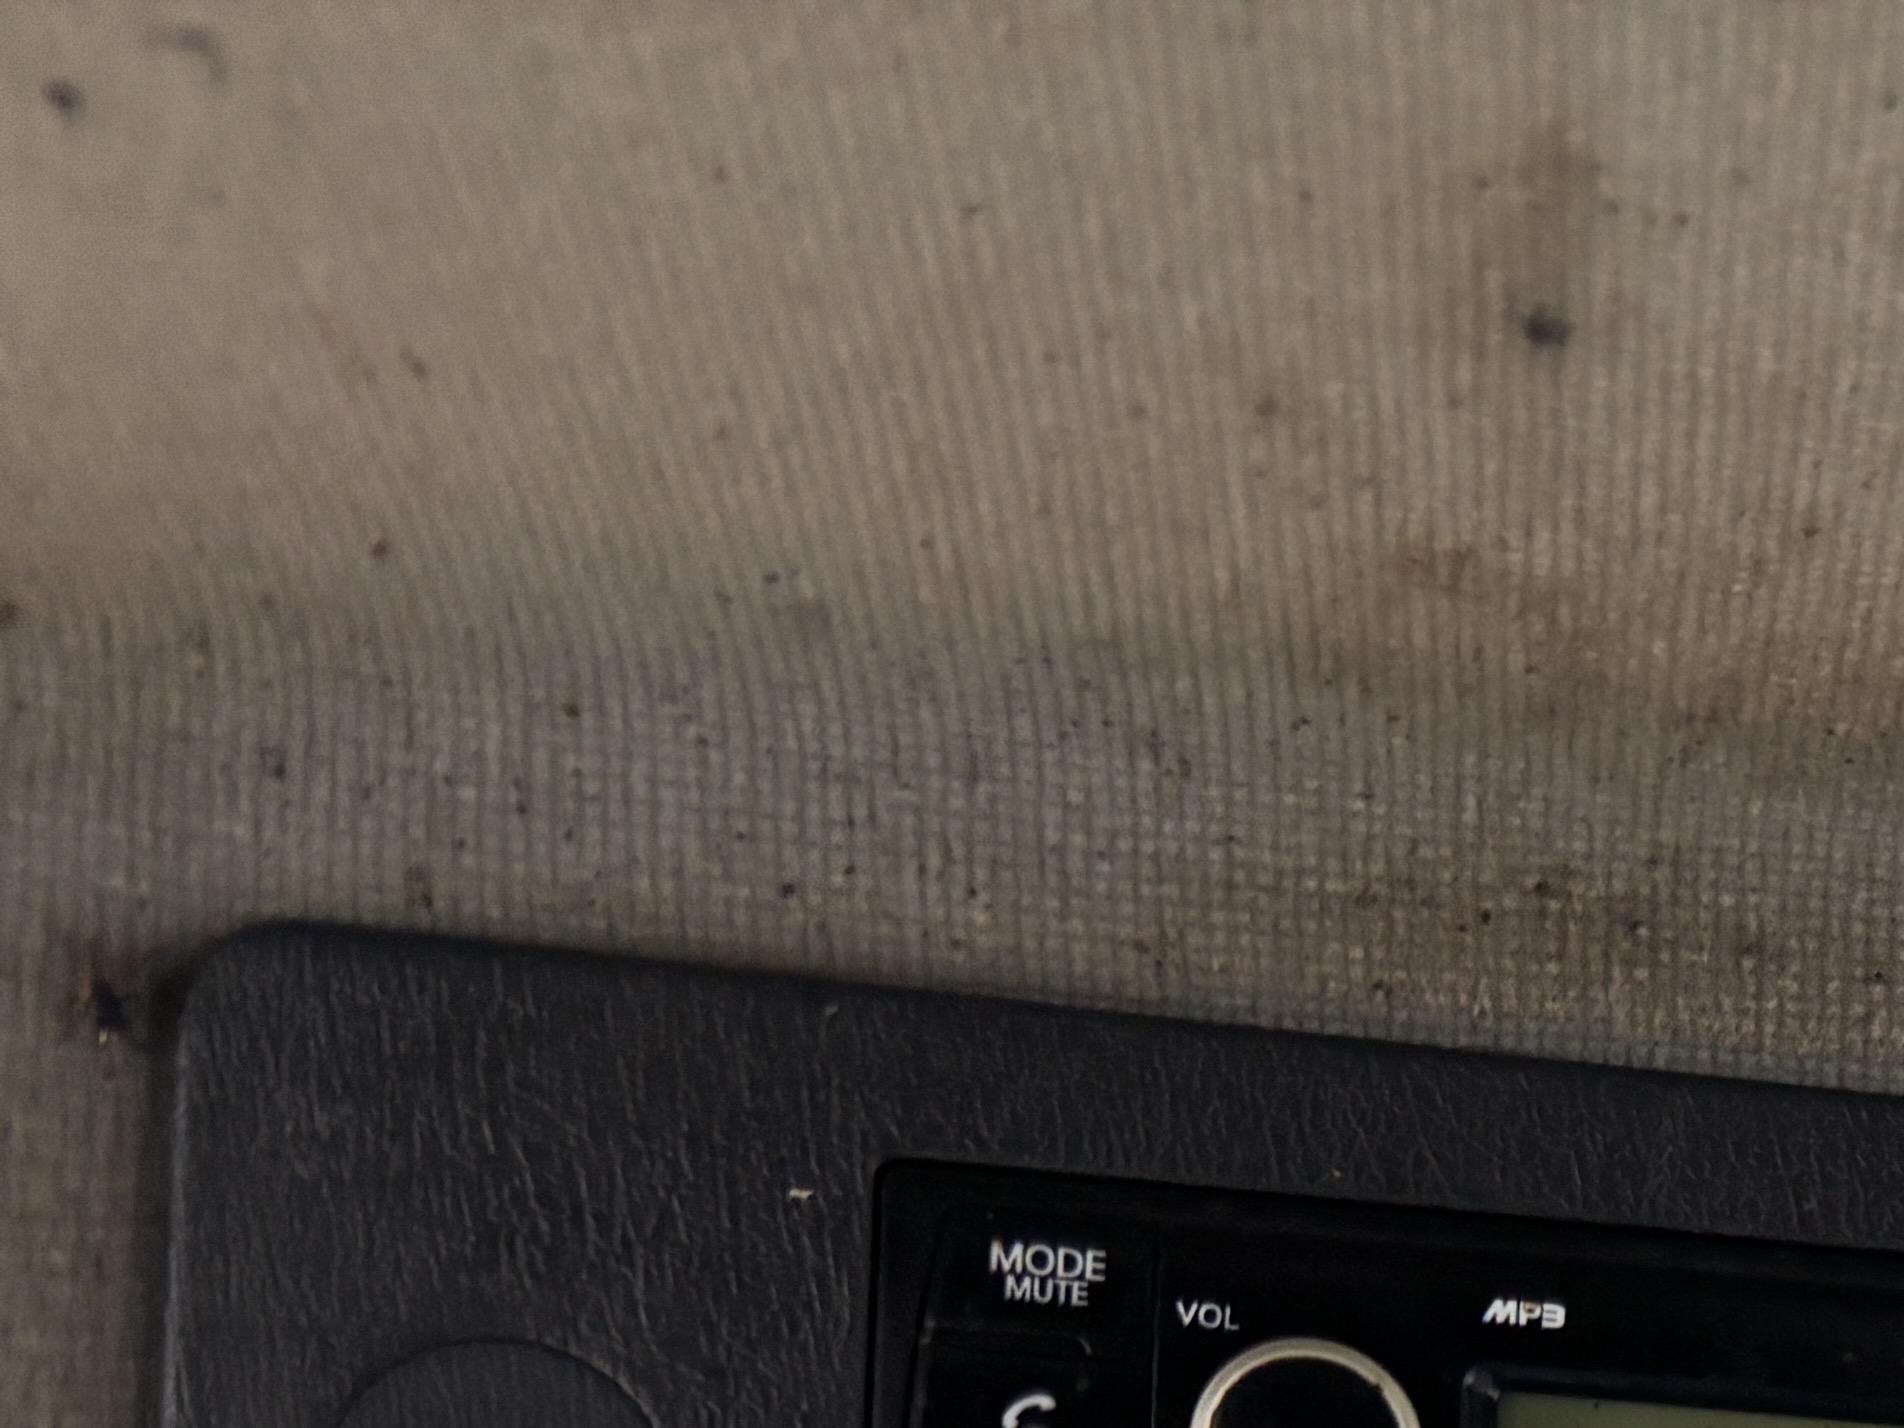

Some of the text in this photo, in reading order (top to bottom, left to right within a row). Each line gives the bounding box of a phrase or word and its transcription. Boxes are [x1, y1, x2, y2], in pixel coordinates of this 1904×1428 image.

[988, 1240, 1108, 1281] MODE
[1003, 1276, 1091, 1307] MUTE
[1175, 1300, 1239, 1331] VOL
[1481, 1297, 1567, 1330] MP3
